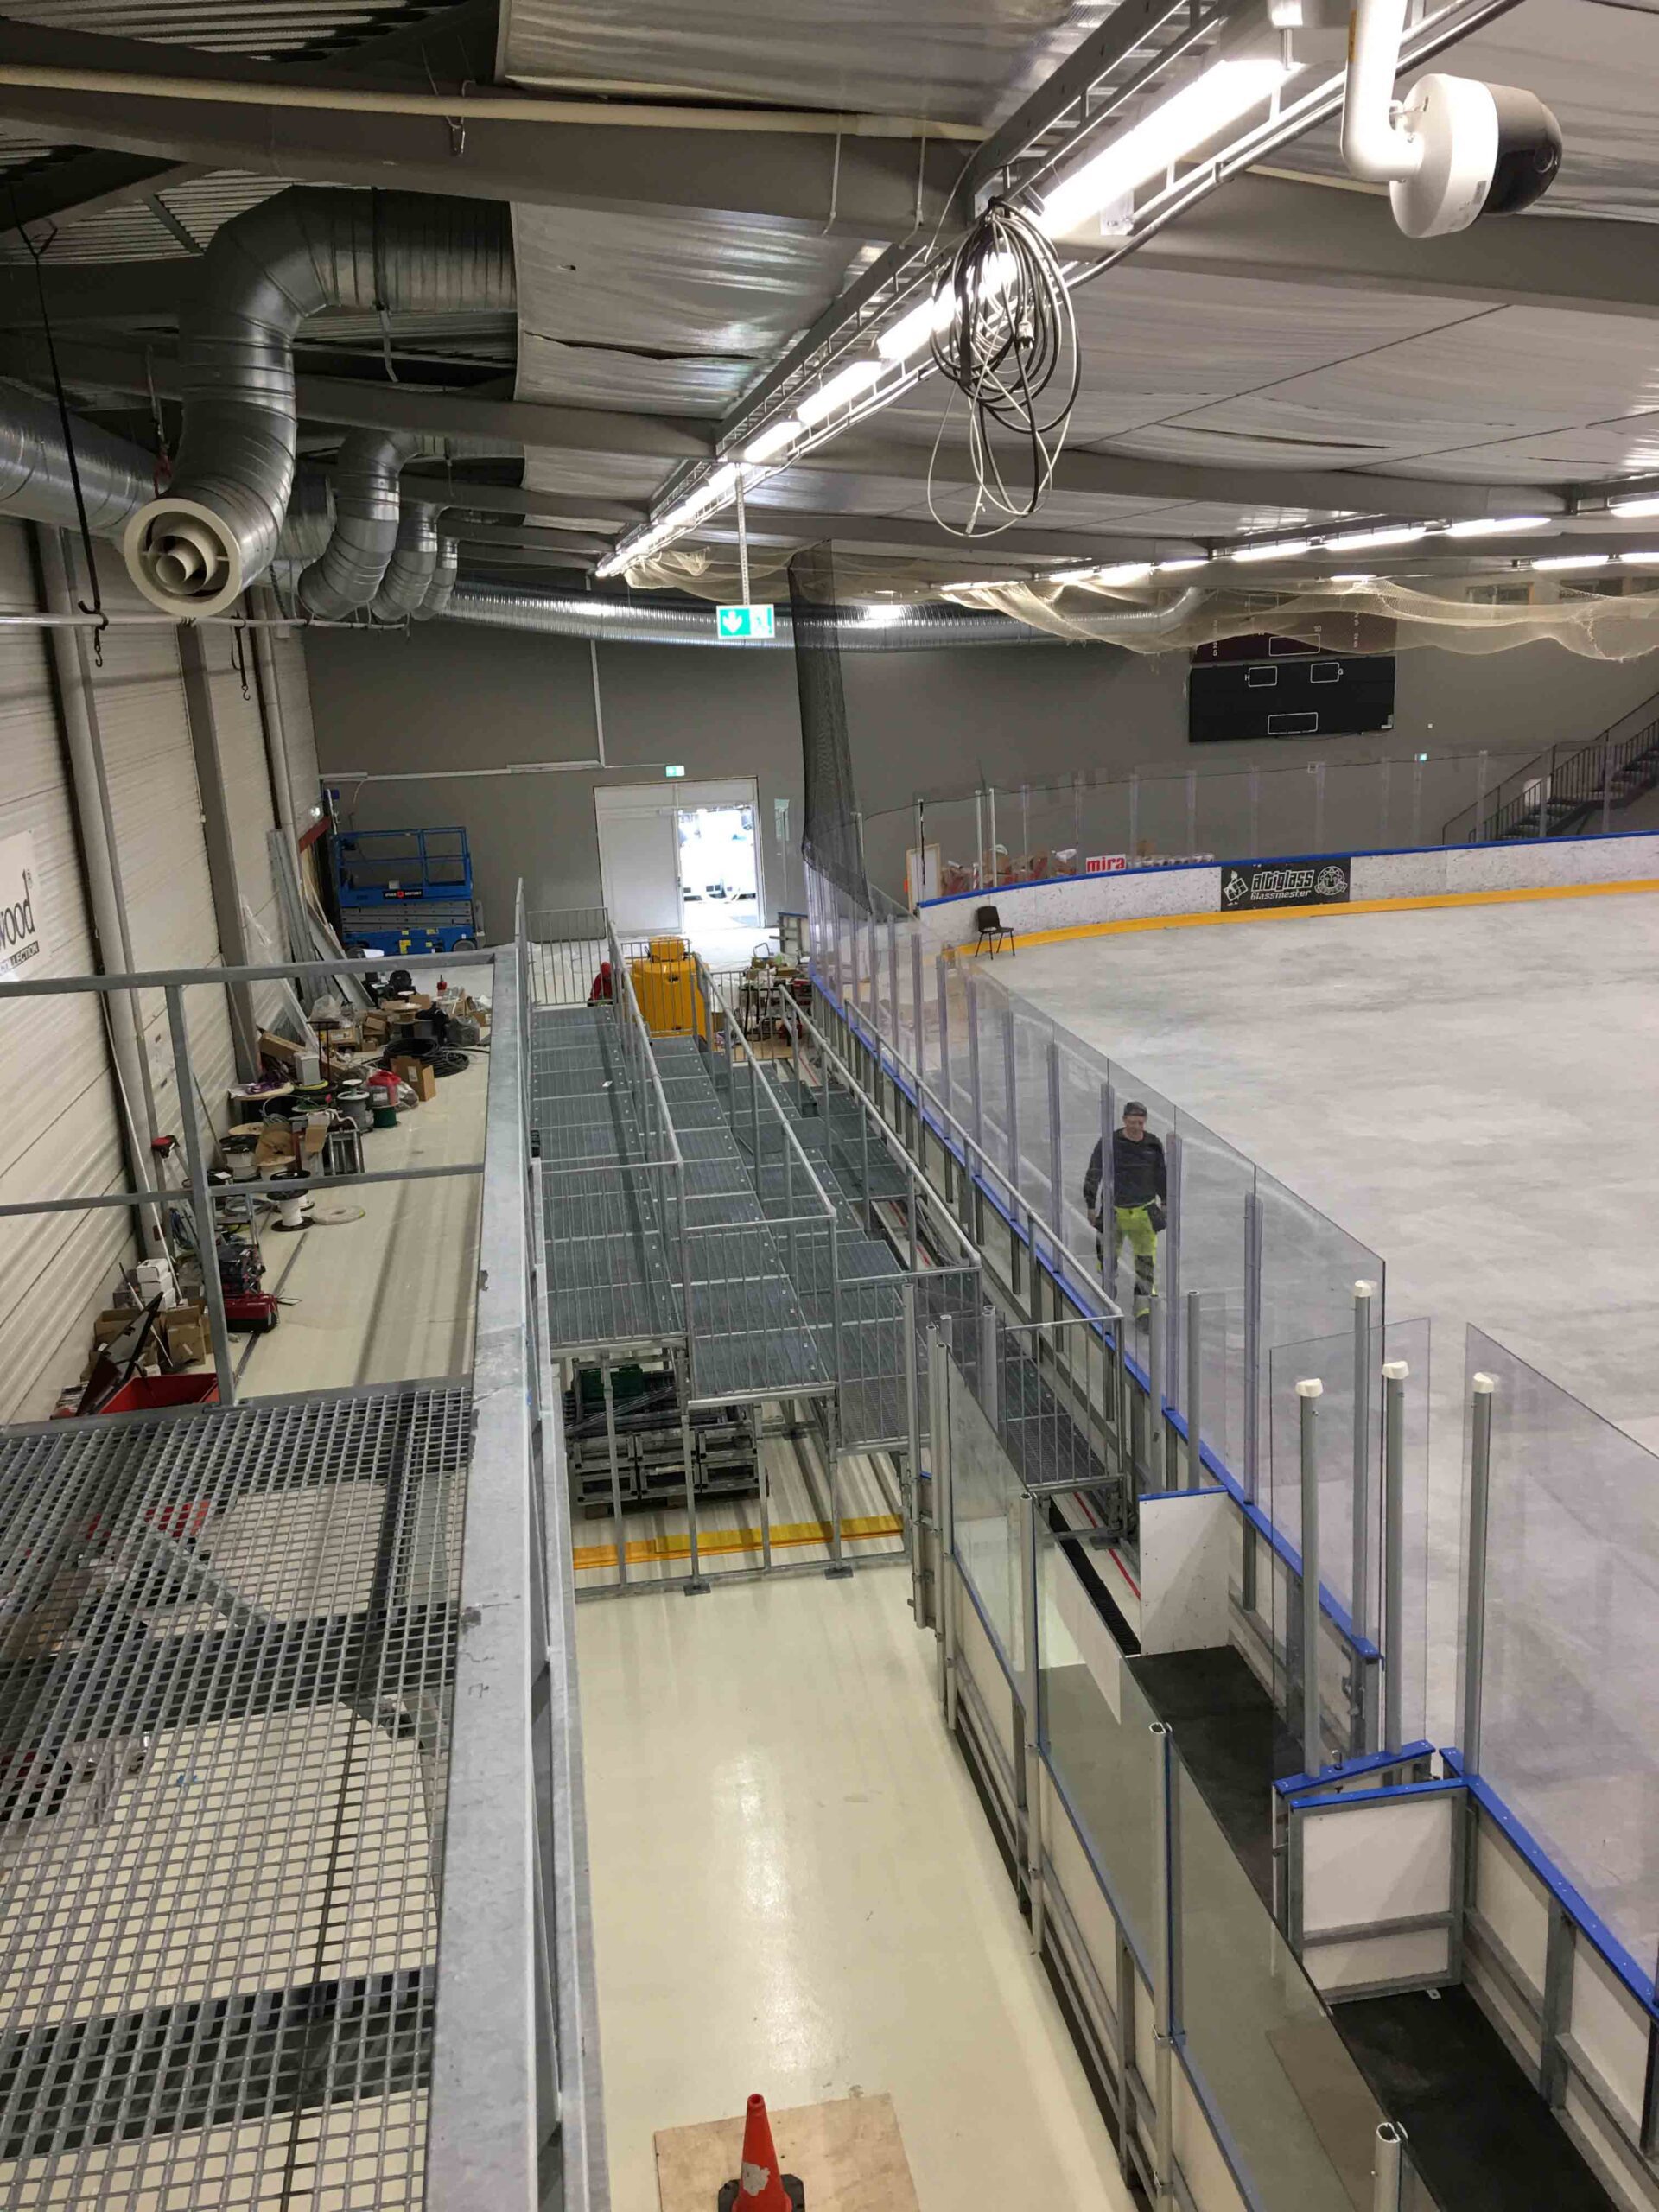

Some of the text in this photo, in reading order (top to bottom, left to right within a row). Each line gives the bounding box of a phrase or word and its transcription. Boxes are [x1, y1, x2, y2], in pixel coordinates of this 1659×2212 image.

[1087, 856, 1125, 872] mira
[1251, 870, 1315, 893] altiglass
[1250, 889, 1312, 900] Glassmester
